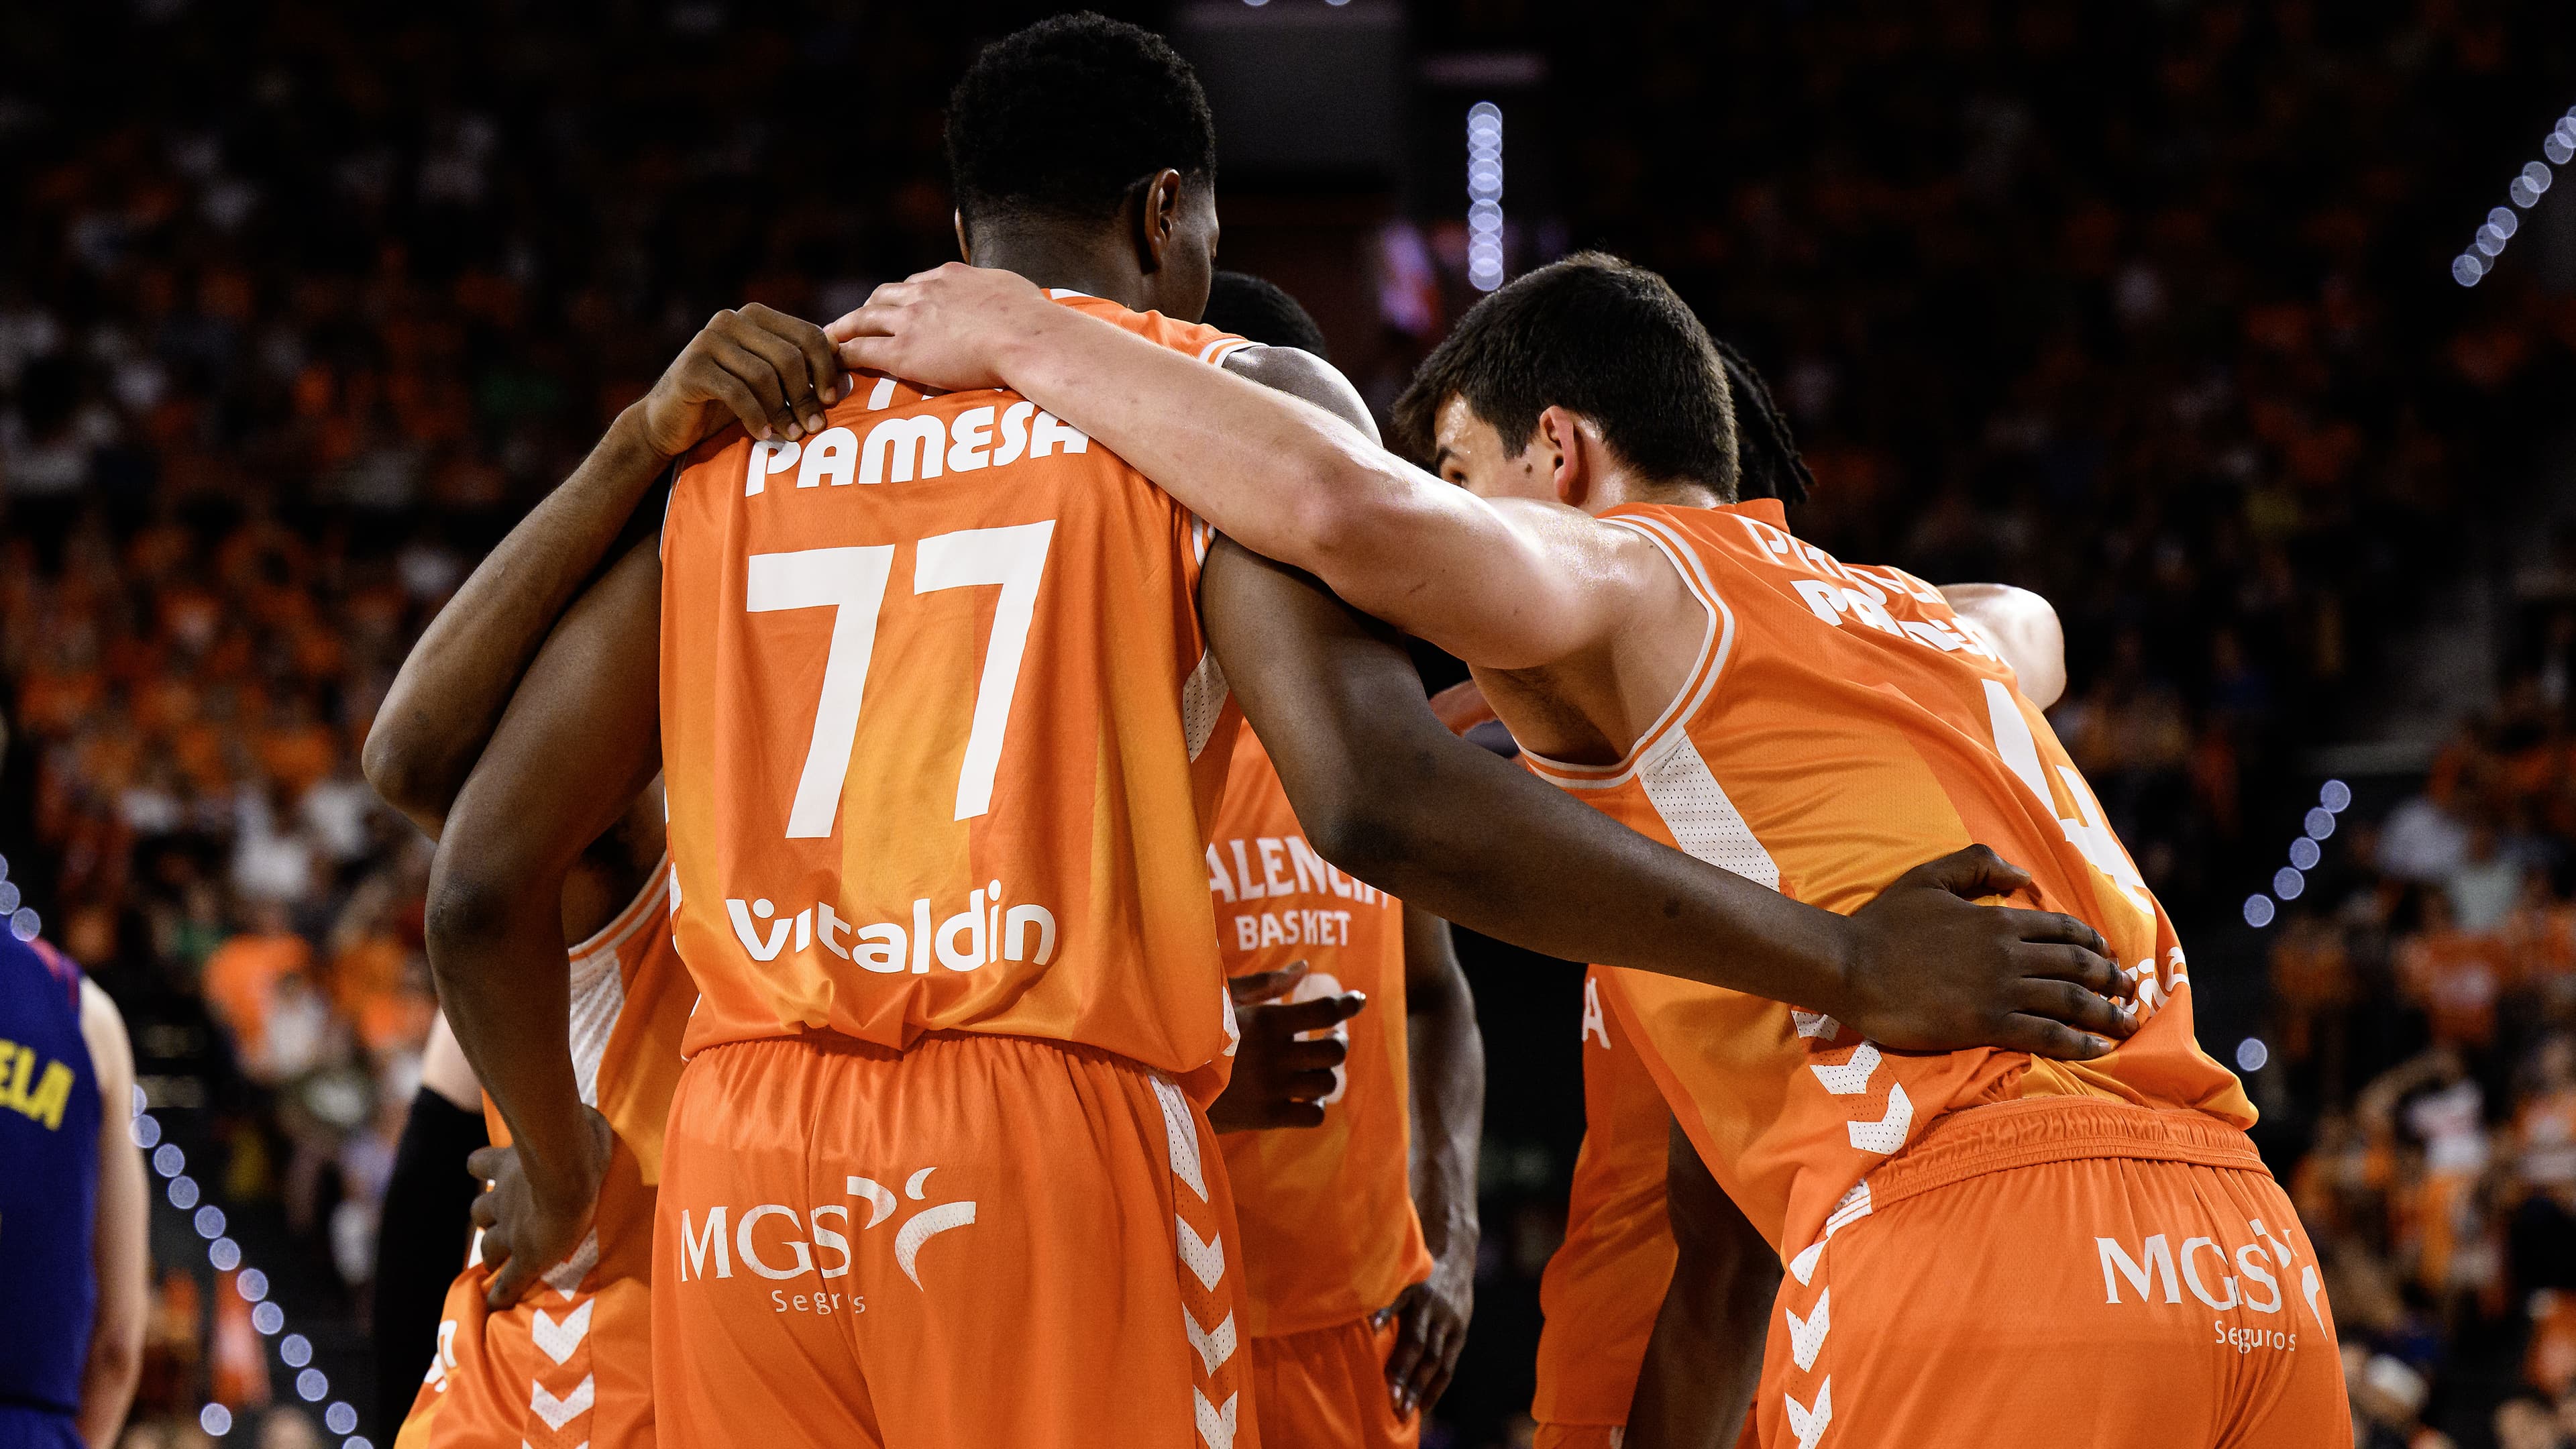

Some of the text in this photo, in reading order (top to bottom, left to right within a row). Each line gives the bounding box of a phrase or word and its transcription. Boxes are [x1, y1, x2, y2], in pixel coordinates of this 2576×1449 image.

[745, 401, 1090, 497] PAMESA
[746, 519, 1057, 839] 77
[1234, 908, 1351, 951] BASKET
[681, 1203, 852, 1283] MGS
[2094, 1233, 2282, 1314] MGS
[2214, 1320, 2296, 1354] Seguros
